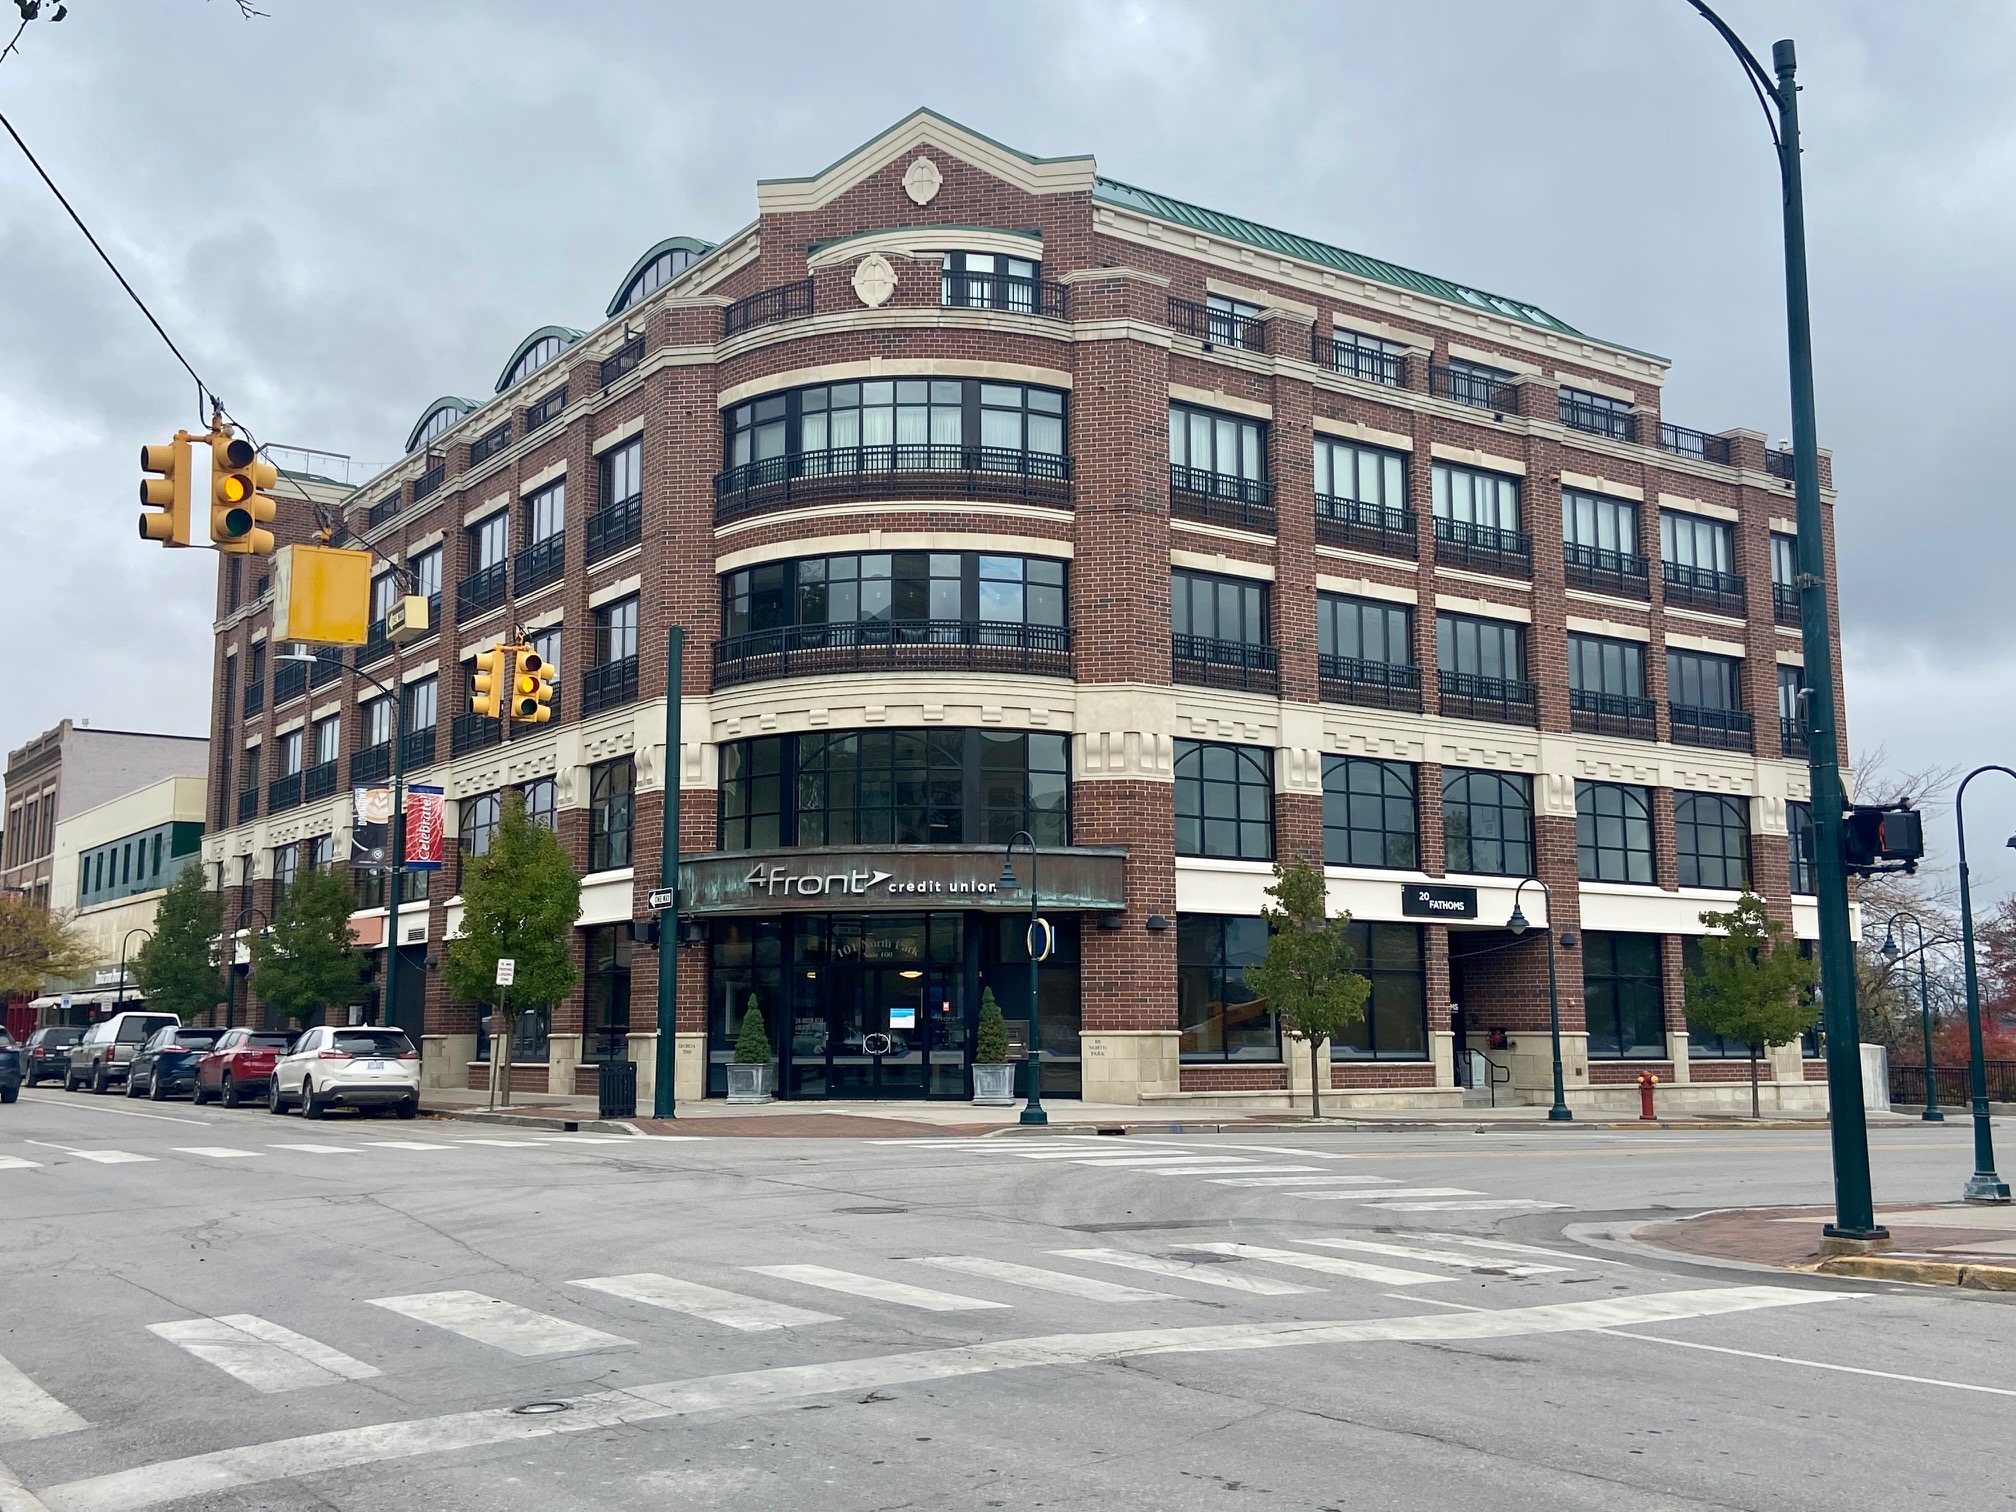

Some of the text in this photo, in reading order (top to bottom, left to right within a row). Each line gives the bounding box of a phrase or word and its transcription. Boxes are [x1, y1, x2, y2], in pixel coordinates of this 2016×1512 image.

[744, 862, 997, 896] 4front credit union
[1418, 892, 1430, 901] 20
[1429, 900, 1465, 911] FATHOMS
[837, 938, 919, 958] 101 North Park
